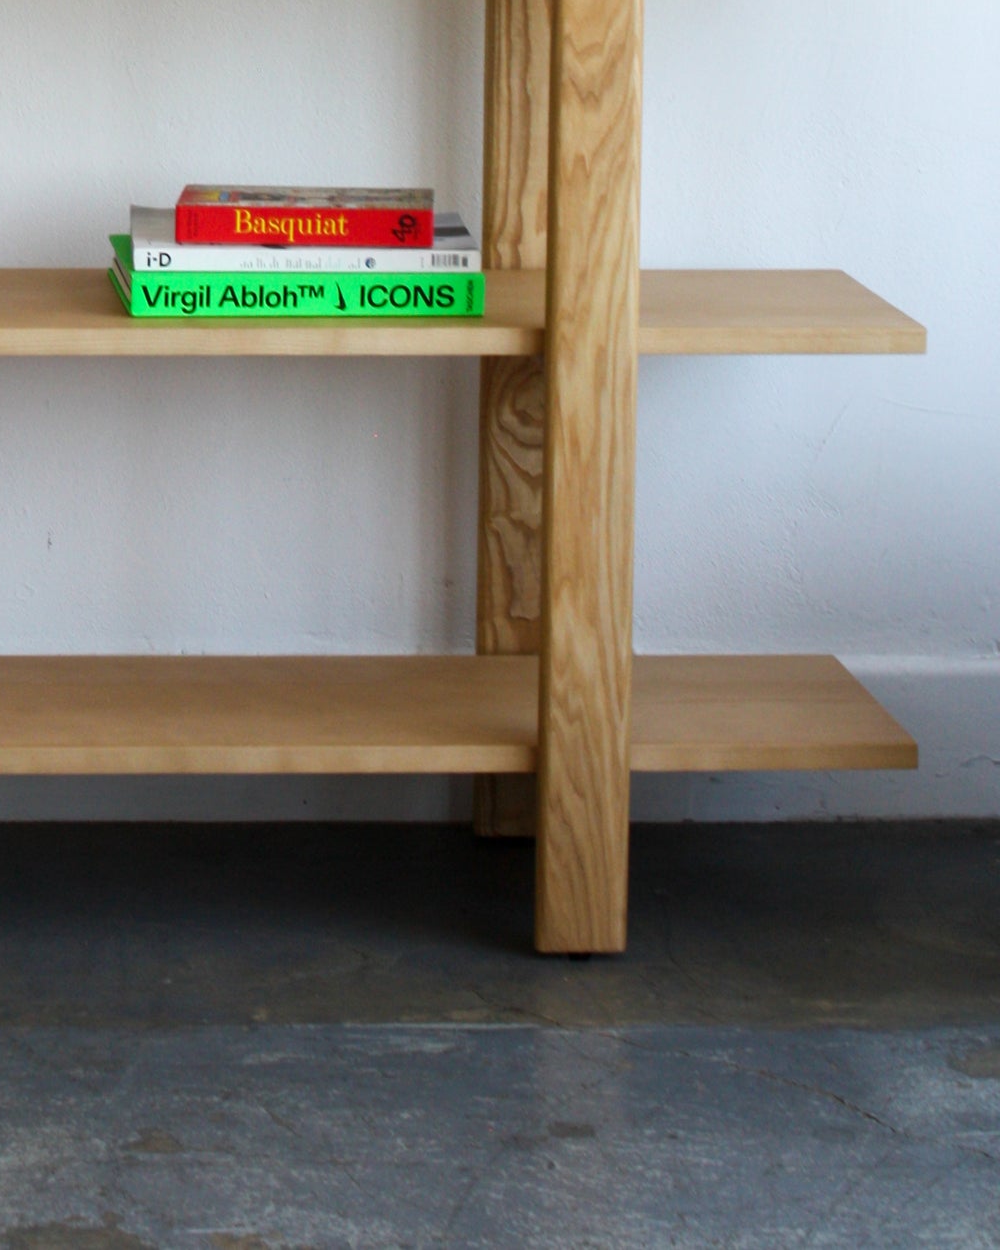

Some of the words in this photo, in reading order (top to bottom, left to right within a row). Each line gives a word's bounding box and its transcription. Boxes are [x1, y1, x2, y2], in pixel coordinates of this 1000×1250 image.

[234, 209, 349, 242] Basquiat
[147, 252, 172, 267] i-D
[141, 285, 211, 314] Virgil
[360, 285, 455, 308] ICONS
